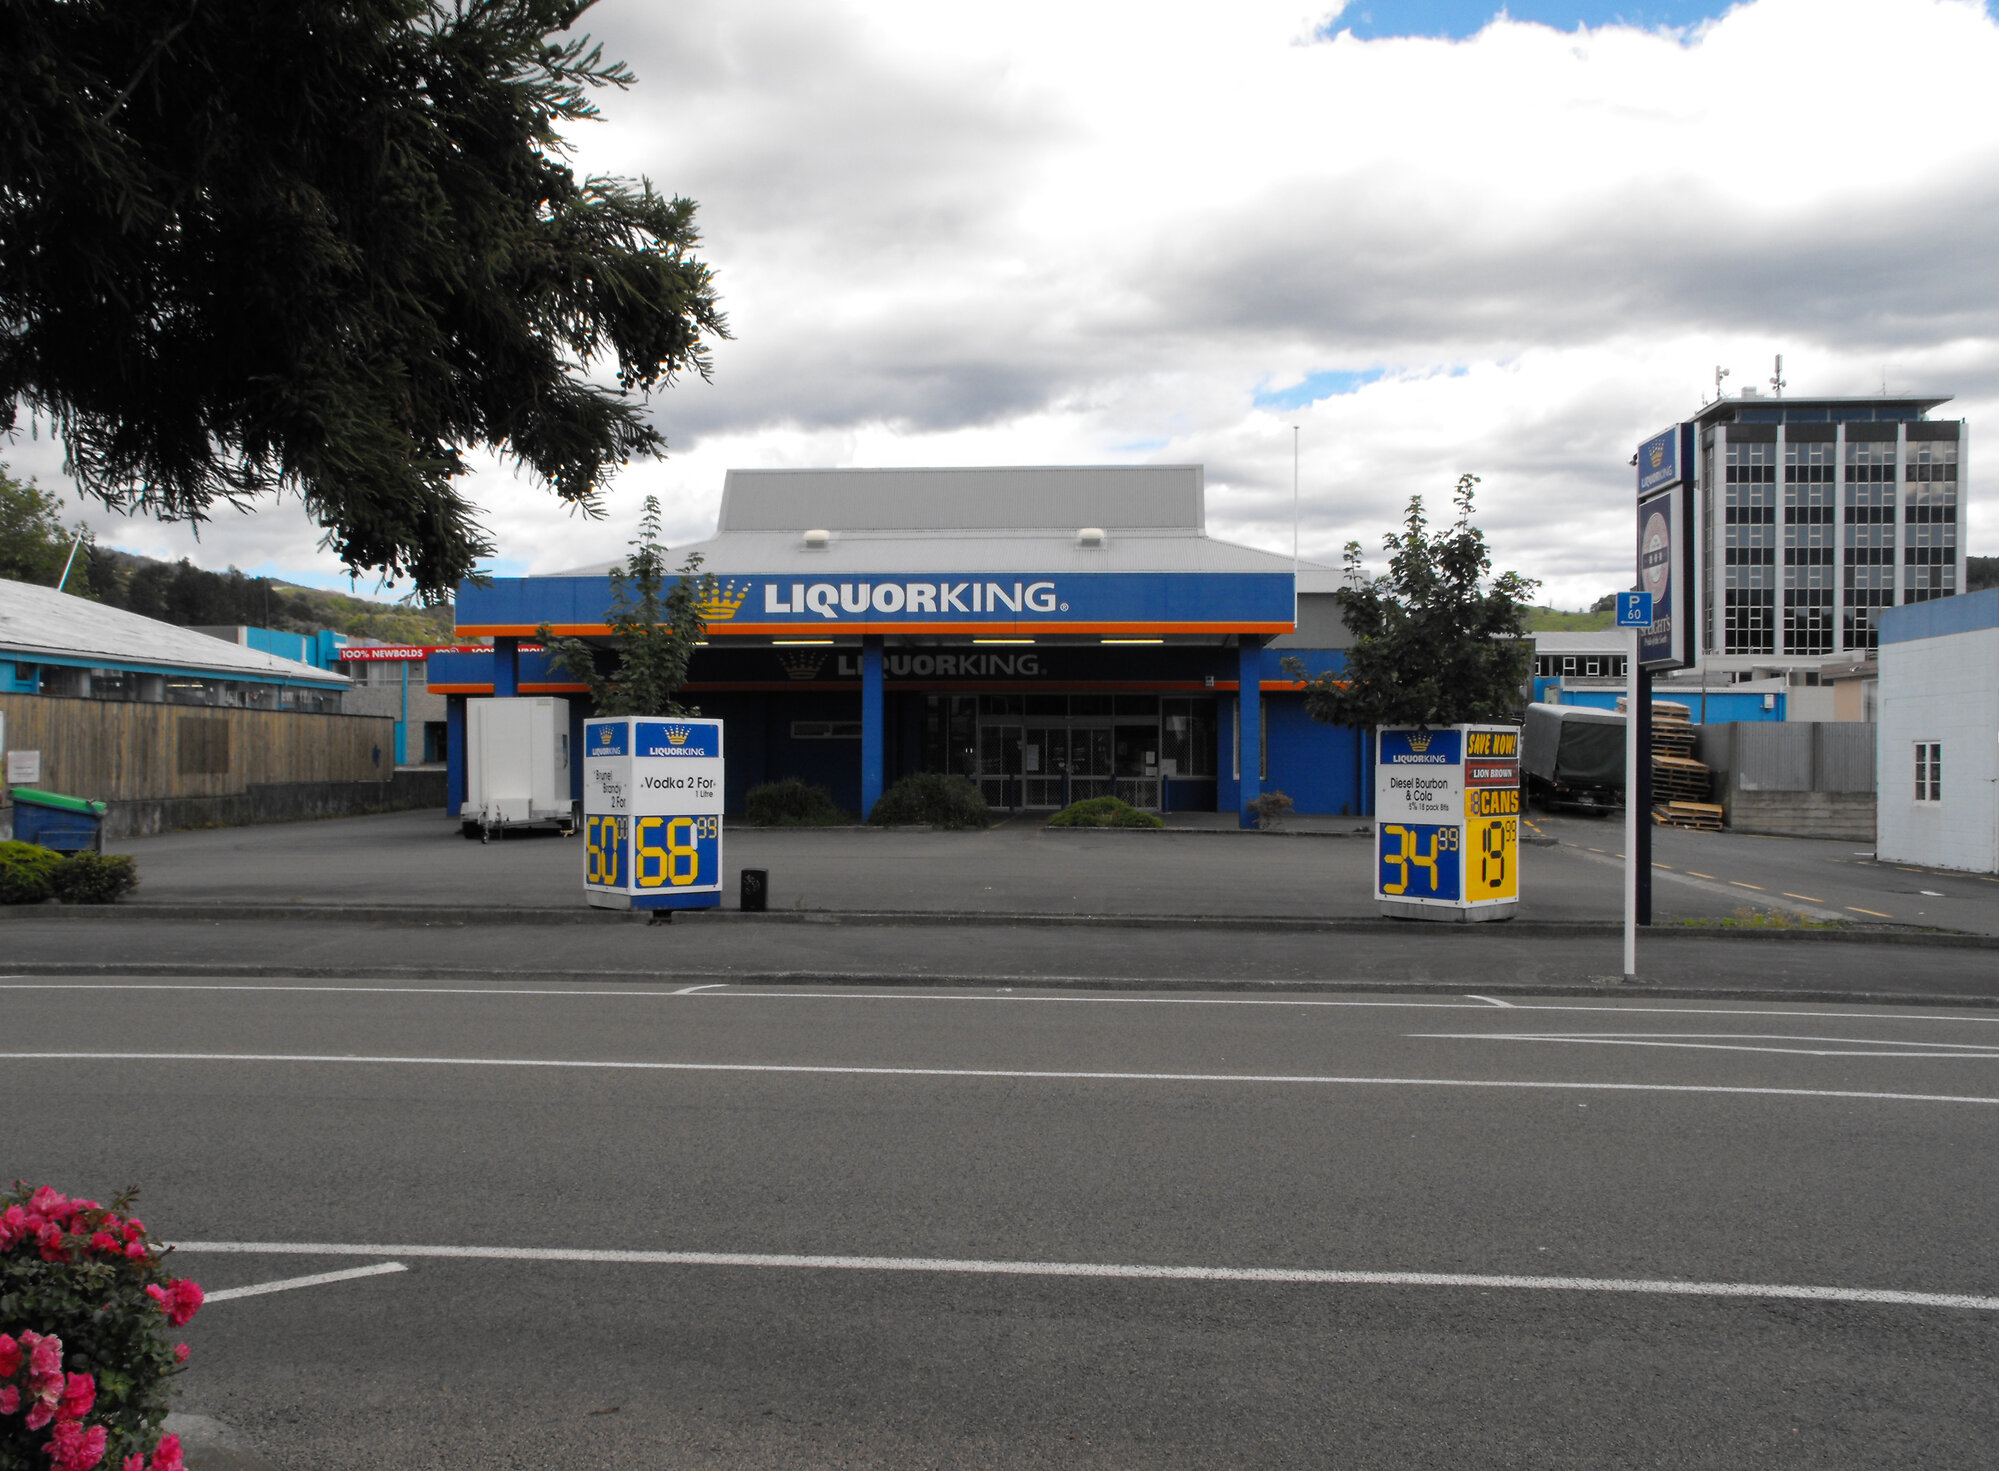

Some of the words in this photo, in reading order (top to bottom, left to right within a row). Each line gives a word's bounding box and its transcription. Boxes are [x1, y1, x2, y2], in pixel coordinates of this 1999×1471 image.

[1629, 595, 1640, 608] P
[1628, 609, 1641, 620] 60
[342, 650, 370, 658] 100%
[372, 649, 423, 658] NEWBOLDS
[838, 654, 1039, 679] LIUORKING
[1468, 733, 1491, 754] SAVE
[1493, 734, 1517, 754] NOW!
[649, 747, 705, 756] LIQUORKING
[1393, 755, 1446, 764] LIQUORKING
[1473, 769, 1490, 778] LION
[1490, 769, 1513, 778] BROWN
[645, 776, 684, 788] Vodka
[688, 777, 694, 788] 2
[697, 777, 713, 788] For
[1391, 777, 1414, 789] Diesel
[1416, 778, 1448, 789] Bourbon
[700, 790, 714, 798] Litre
[1405, 790, 1411, 800] &
[1413, 790, 1432, 801] Cola
[611, 796, 616, 808] 2
[617, 796, 626, 808] For
[1481, 790, 1519, 814] CANS
[1426, 804, 1439, 812] pack
